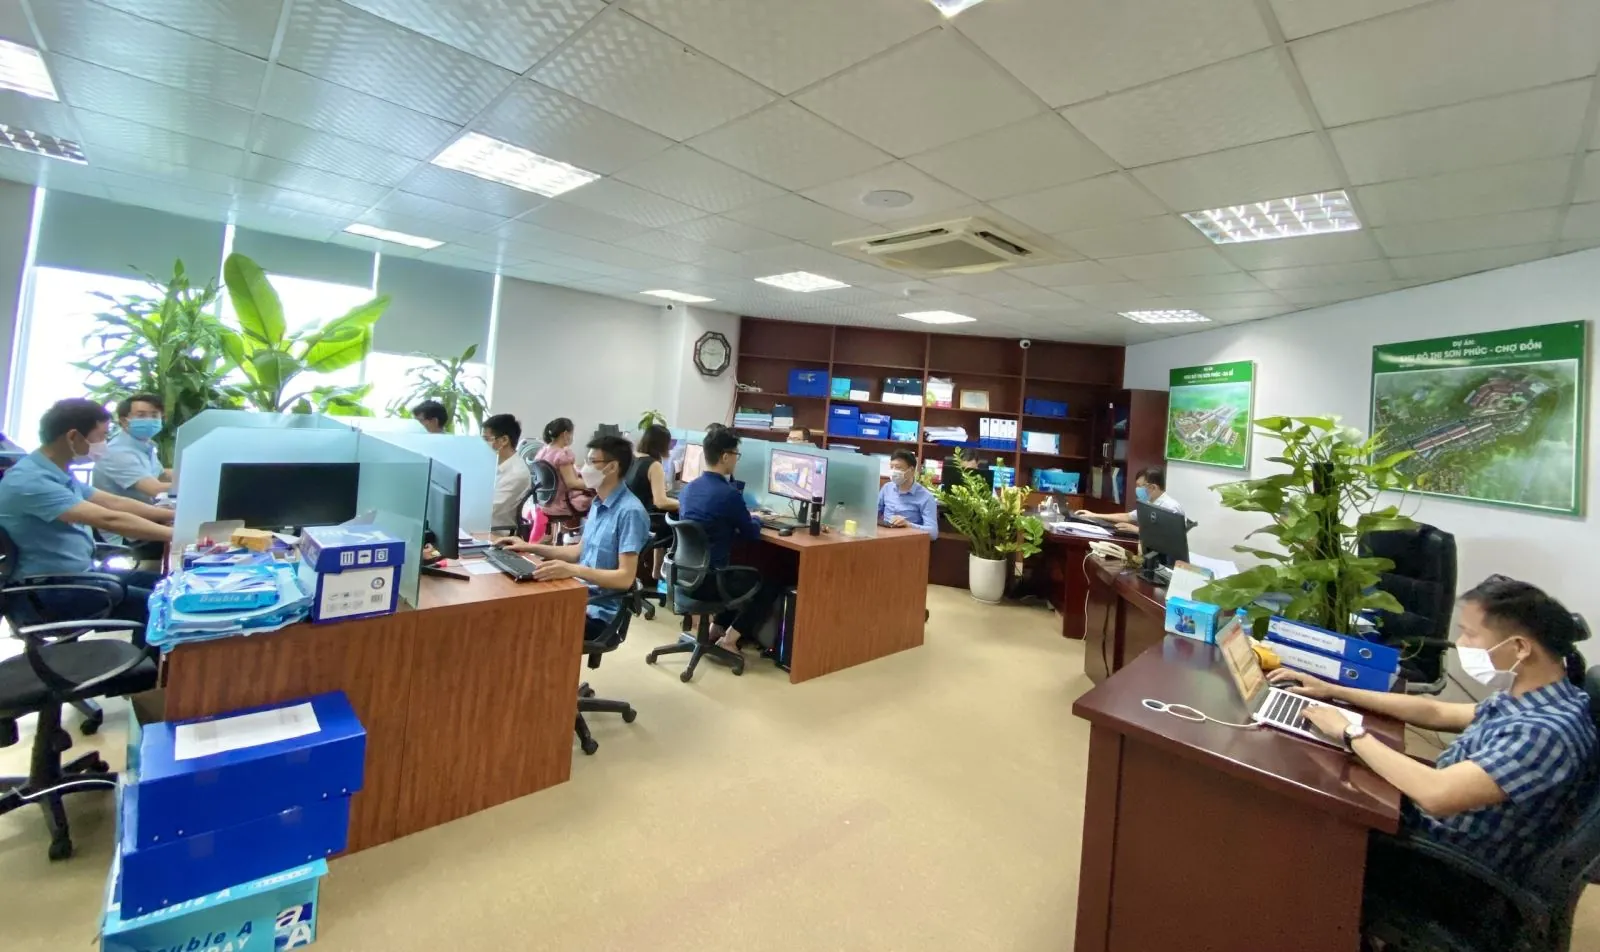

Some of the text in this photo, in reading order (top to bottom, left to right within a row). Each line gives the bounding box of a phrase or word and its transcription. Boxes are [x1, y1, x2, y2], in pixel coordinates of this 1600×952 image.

[1463, 345, 1488, 356] PHÚC
[1495, 342, 1518, 353] CHỢ
[236, 920, 252, 938] A
